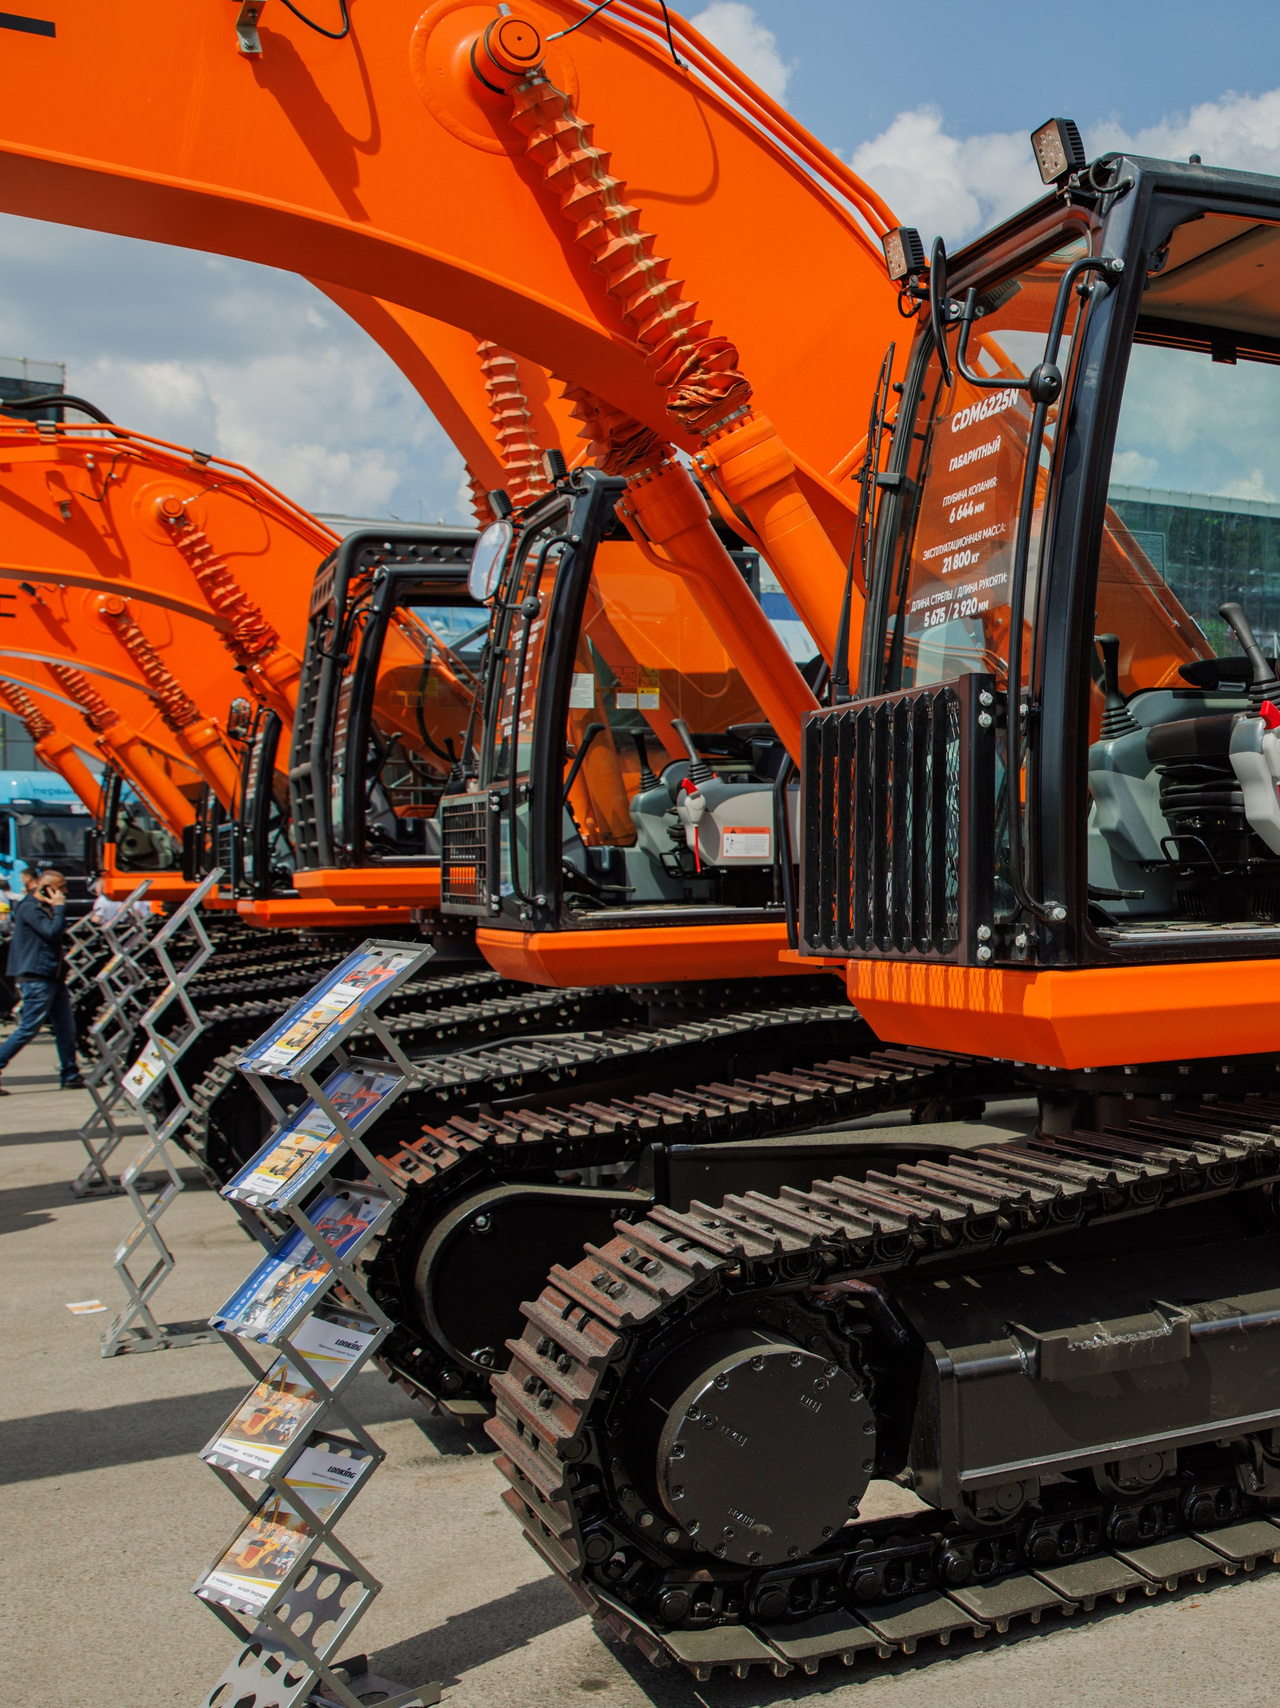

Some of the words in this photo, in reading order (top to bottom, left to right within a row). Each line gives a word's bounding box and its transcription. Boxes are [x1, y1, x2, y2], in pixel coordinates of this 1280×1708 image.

[951, 388, 1020, 434] CDM6225N
[948, 435, 1001, 472] ГАБАРИТНЫЙ
[942, 490, 968, 507] ГЛУБИНА
[967, 476, 998, 497] КОПАНИЯ:
[949, 507, 956, 524] 6
[956, 500, 974, 521] 644
[922, 530, 982, 560] ЭКСПЛУАТАЦИОННАЯ
[982, 522, 1006, 539] МАССА:
[942, 556, 952, 574] 21
[952, 549, 971, 570] 800
[911, 600, 930, 613] ДЛИНА
[930, 589, 953, 606] СТРЕЛЫ
[957, 581, 978, 599] ДЛИНА
[978, 572, 1007, 590] РУКОЯТИ:
[923, 612, 930, 628] 5
[930, 607, 946, 626] 675
[952, 602, 959, 619] 2
[960, 597, 978, 617] 920
